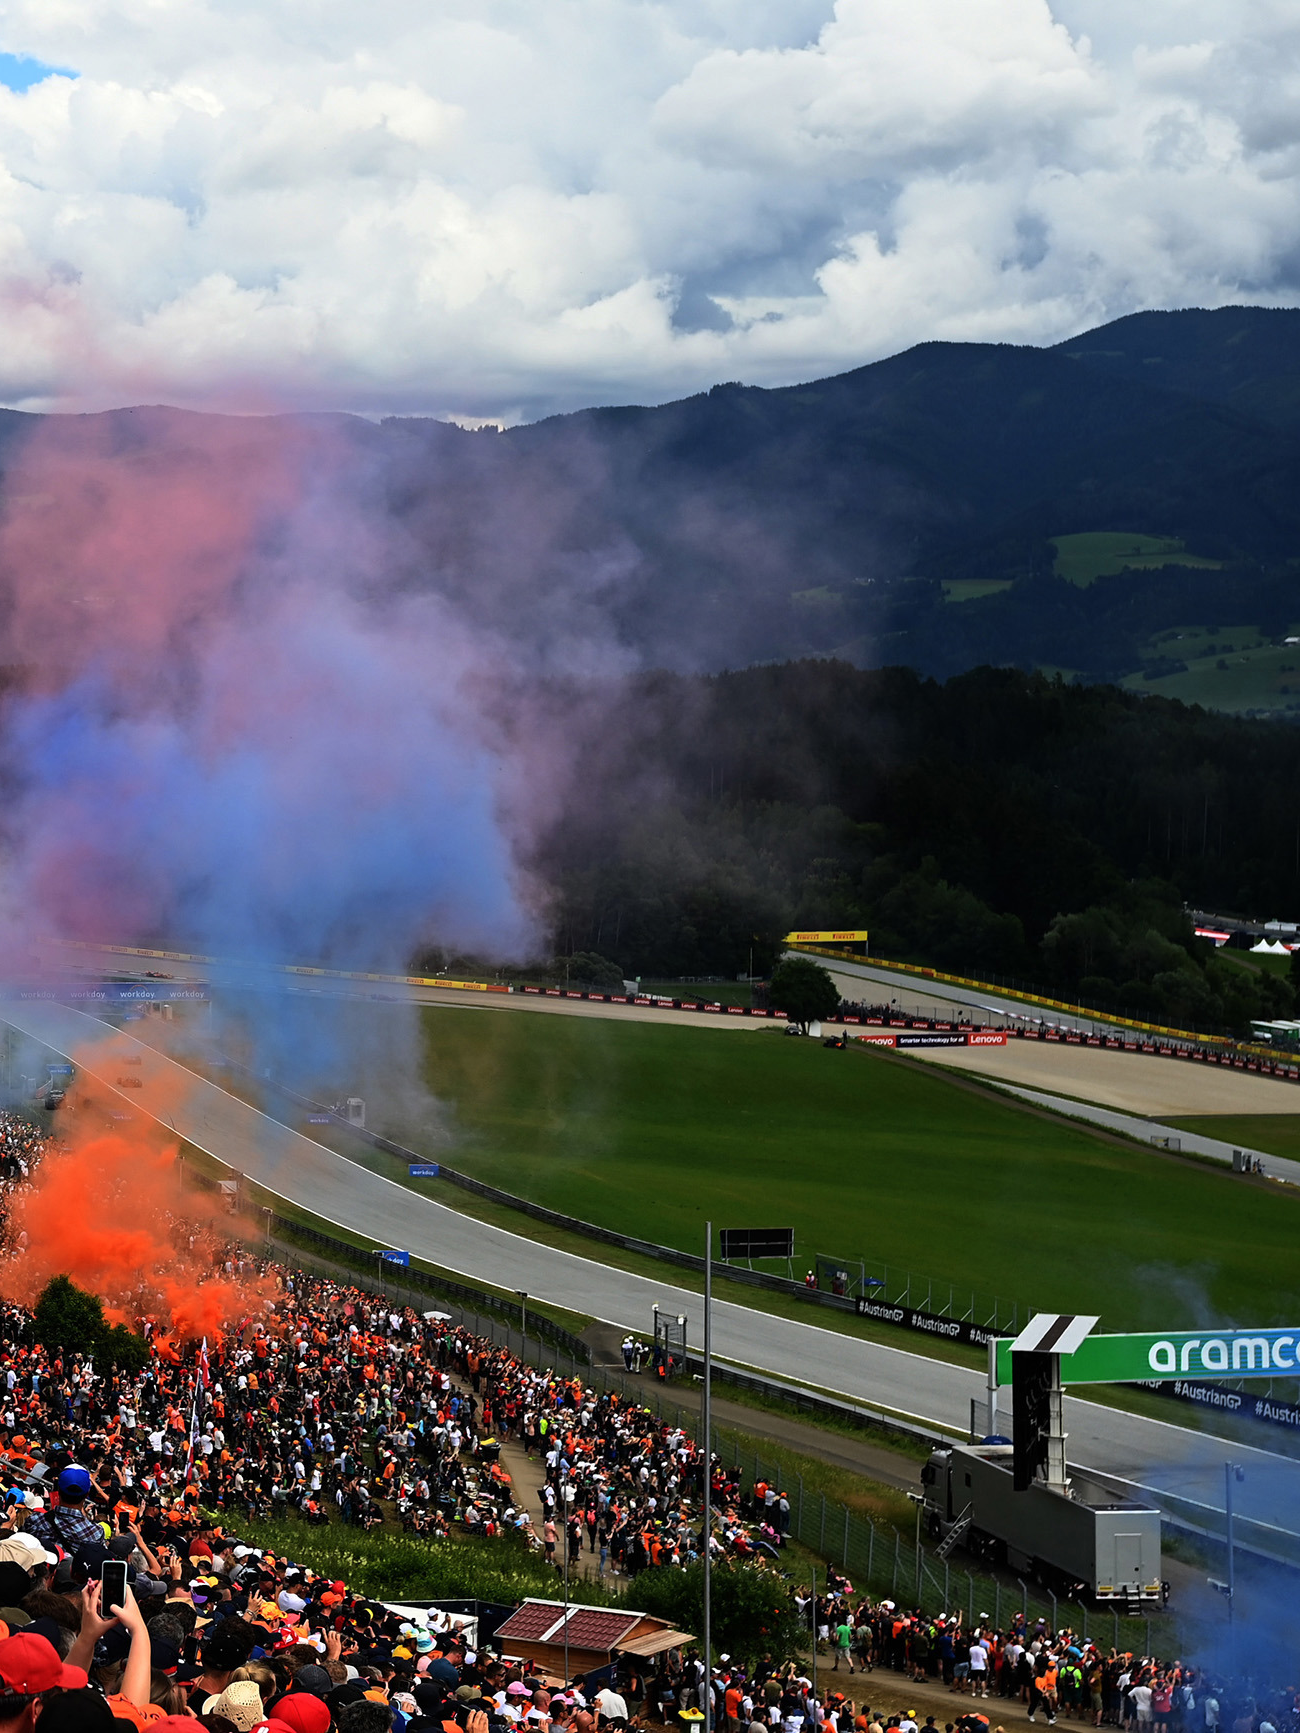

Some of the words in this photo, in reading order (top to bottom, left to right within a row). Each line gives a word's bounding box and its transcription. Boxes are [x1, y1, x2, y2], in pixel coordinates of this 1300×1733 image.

[70, 991, 105, 999] workday
[120, 991, 155, 999] workday
[971, 1034, 1002, 1043] Lenovo
[859, 1300, 904, 1322] #AustrianGP
[911, 1313, 960, 1337] #AustrianGP
[1174, 1381, 1241, 1410] #AustrianGP
